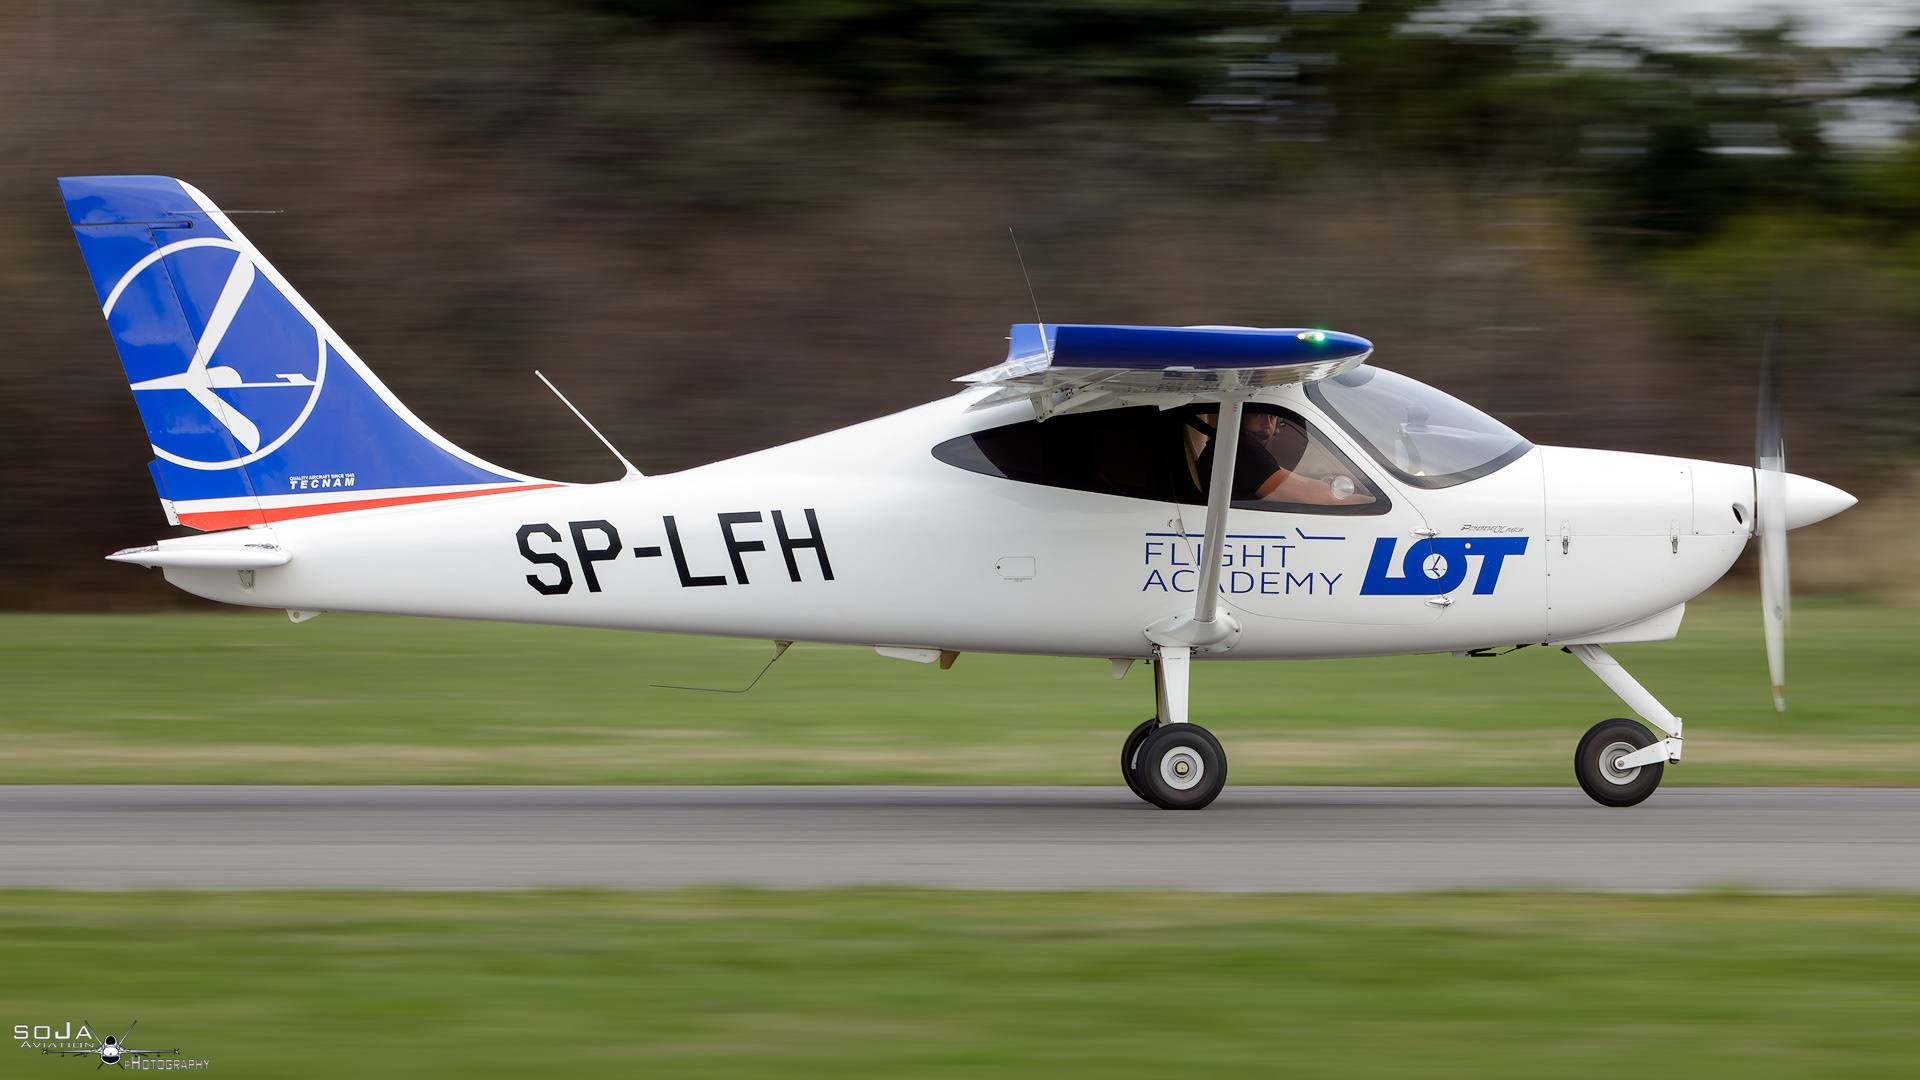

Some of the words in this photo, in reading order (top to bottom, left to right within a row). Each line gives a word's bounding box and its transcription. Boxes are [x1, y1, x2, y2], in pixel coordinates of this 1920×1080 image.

[290, 478, 355, 490] TECNAM
[515, 508, 835, 596] SP-LFH
[1359, 536, 1530, 596] LOT
[1142, 569, 1344, 596] ACDEMY
